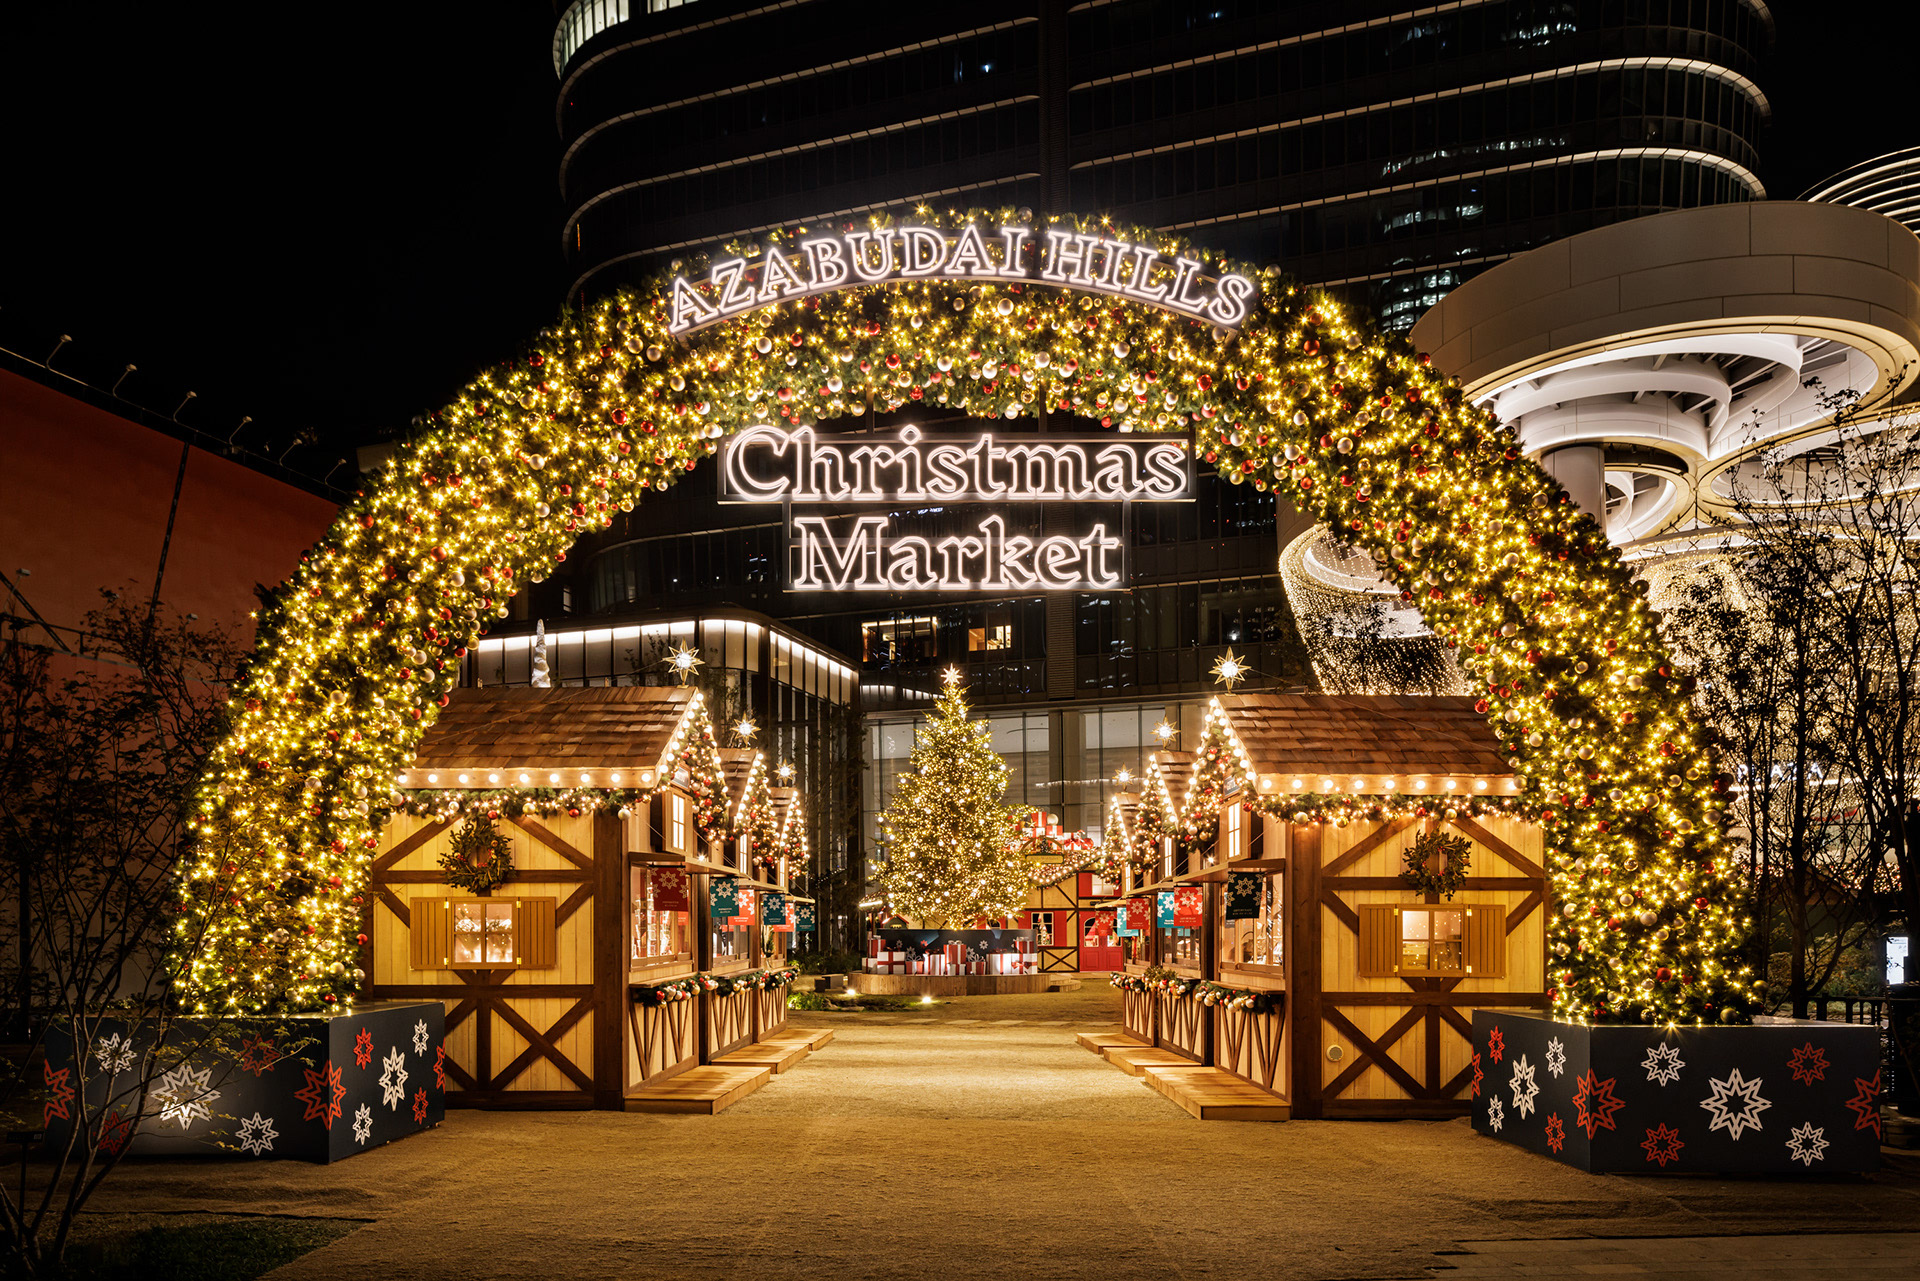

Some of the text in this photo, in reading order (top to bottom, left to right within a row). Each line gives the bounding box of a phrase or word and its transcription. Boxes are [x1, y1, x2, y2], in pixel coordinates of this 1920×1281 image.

[669, 224, 1254, 334] AZABUDAI HILLS
[725, 424, 1187, 501] Christmas
[793, 515, 1120, 592] Market
